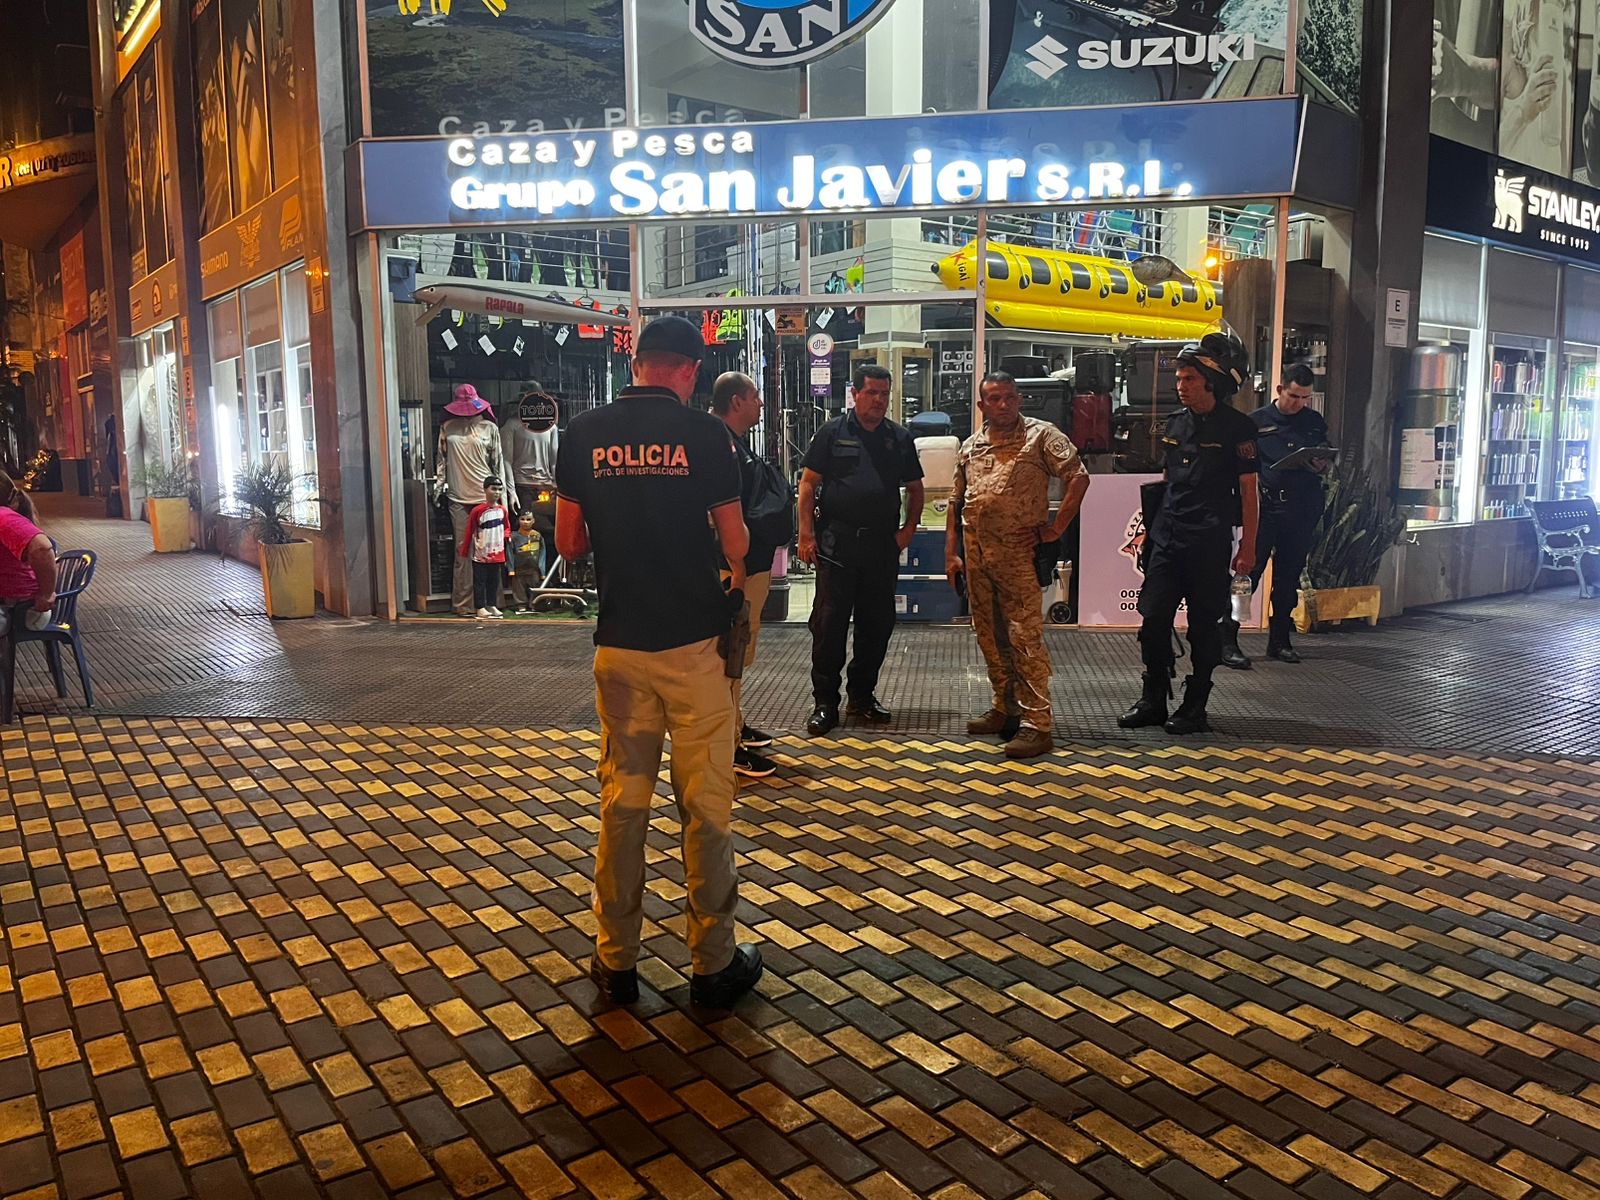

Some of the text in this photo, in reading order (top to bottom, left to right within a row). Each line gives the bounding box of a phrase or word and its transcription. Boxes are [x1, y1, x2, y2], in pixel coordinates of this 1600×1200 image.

[704, 0, 840, 53] SAN
[1077, 33, 1255, 70] SUZUKI
[447, 129, 754, 167] Caza y Pesca
[449, 175, 596, 214] Grupo
[609, 160, 757, 215] San
[776, 148, 1027, 209] Javier
[1540, 229, 1590, 251] SINCE 1913
[1395, 299, 1401, 312] E
[592, 444, 689, 469] POLICIA
[593, 467, 690, 478] DPTO. DE INVESTIGACIONES
